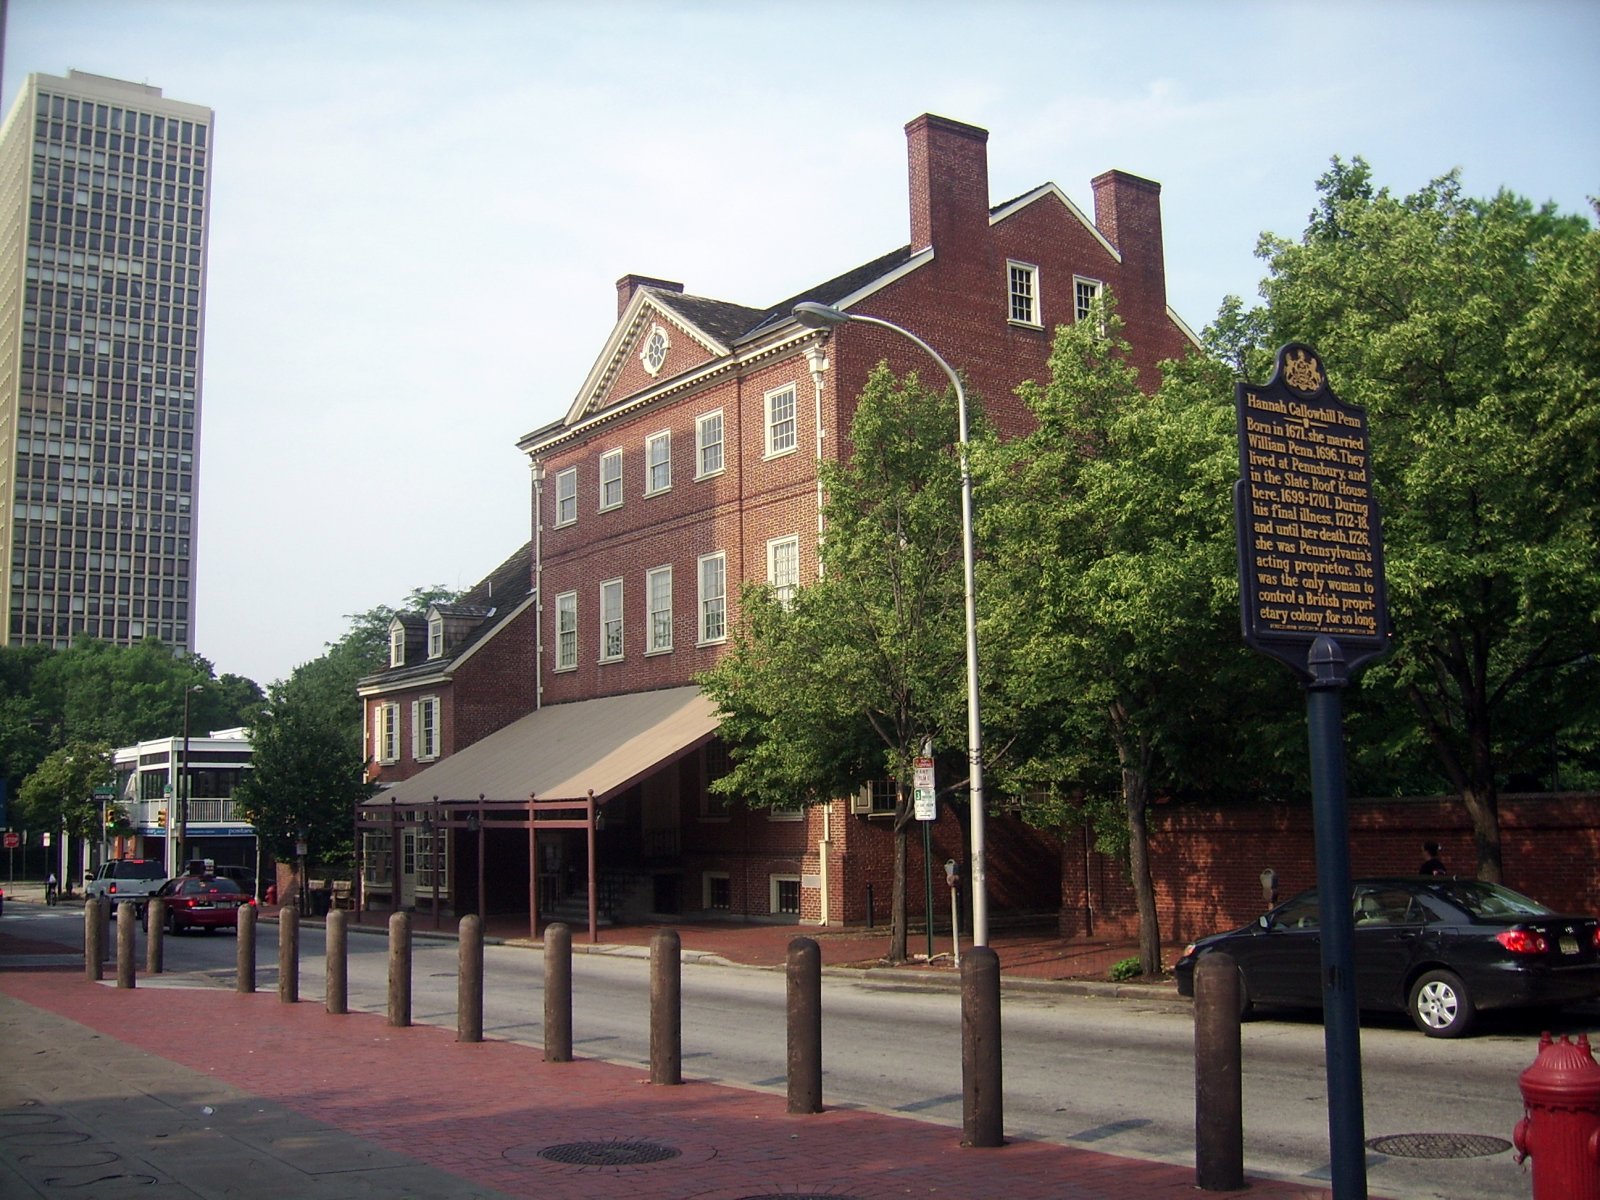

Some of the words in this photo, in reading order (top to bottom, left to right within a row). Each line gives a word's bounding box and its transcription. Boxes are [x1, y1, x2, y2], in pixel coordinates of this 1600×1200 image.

[1247, 393, 1286, 414] Hannah
[1289, 402, 1336, 422] Callowhill
[1337, 411, 1361, 427] Penn
[1247, 417, 1271, 431] Born
[1273, 422, 1283, 435] in
[1308, 430, 1325, 443] she
[1327, 436, 1364, 450] married
[1248, 434, 1286, 453] William
[1316, 446, 1339, 461] 1696.
[1340, 450, 1365, 467] They
[1249, 450, 1275, 467] lived
[1279, 459, 1288, 469] at
[1292, 458, 1346, 480] Pennsbury,
[1348, 469, 1366, 481] and
[1251, 467, 1261, 481] in
[1264, 470, 1281, 484] the
[1285, 473, 1309, 488] Slate
[1312, 477, 1336, 492] Roof
[1338, 481, 1367, 497] House
[1252, 485, 1279, 502] here,
[1281, 489, 1332, 509] 1699-1701.
[1335, 497, 1368, 516] During
[1253, 502, 1269, 516] his
[1272, 504, 1297, 520] final
[1300, 508, 1333, 526] illness,
[1336, 513, 1369, 530] 1712-18,
[1254, 521, 1273, 534] and
[1276, 523, 1299, 537] until
[1301, 524, 1318, 539] her
[1349, 531, 1370, 547] 1726,
[1255, 536, 1273, 550] she
[1277, 542, 1295, 553] was
[1300, 541, 1372, 561] Pennsylvania's
[1257, 555, 1289, 572] acting
[1295, 560, 1352, 576] proprietor.
[1355, 565, 1373, 577] She
[1258, 573, 1277, 584] was
[1281, 574, 1298, 587] the
[1302, 575, 1324, 592] only
[1328, 581, 1361, 592] woman
[1364, 582, 1374, 593] to
[1259, 590, 1295, 604] control
[1298, 595, 1304, 604] a
[1306, 592, 1339, 608] British
[1342, 597, 1375, 613] propri-
[1260, 607, 1288, 624] etary
[1291, 608, 1323, 626] colony
[1326, 610, 1340, 623] for
[1342, 614, 1353, 624] so
[1355, 612, 1376, 628] long.
